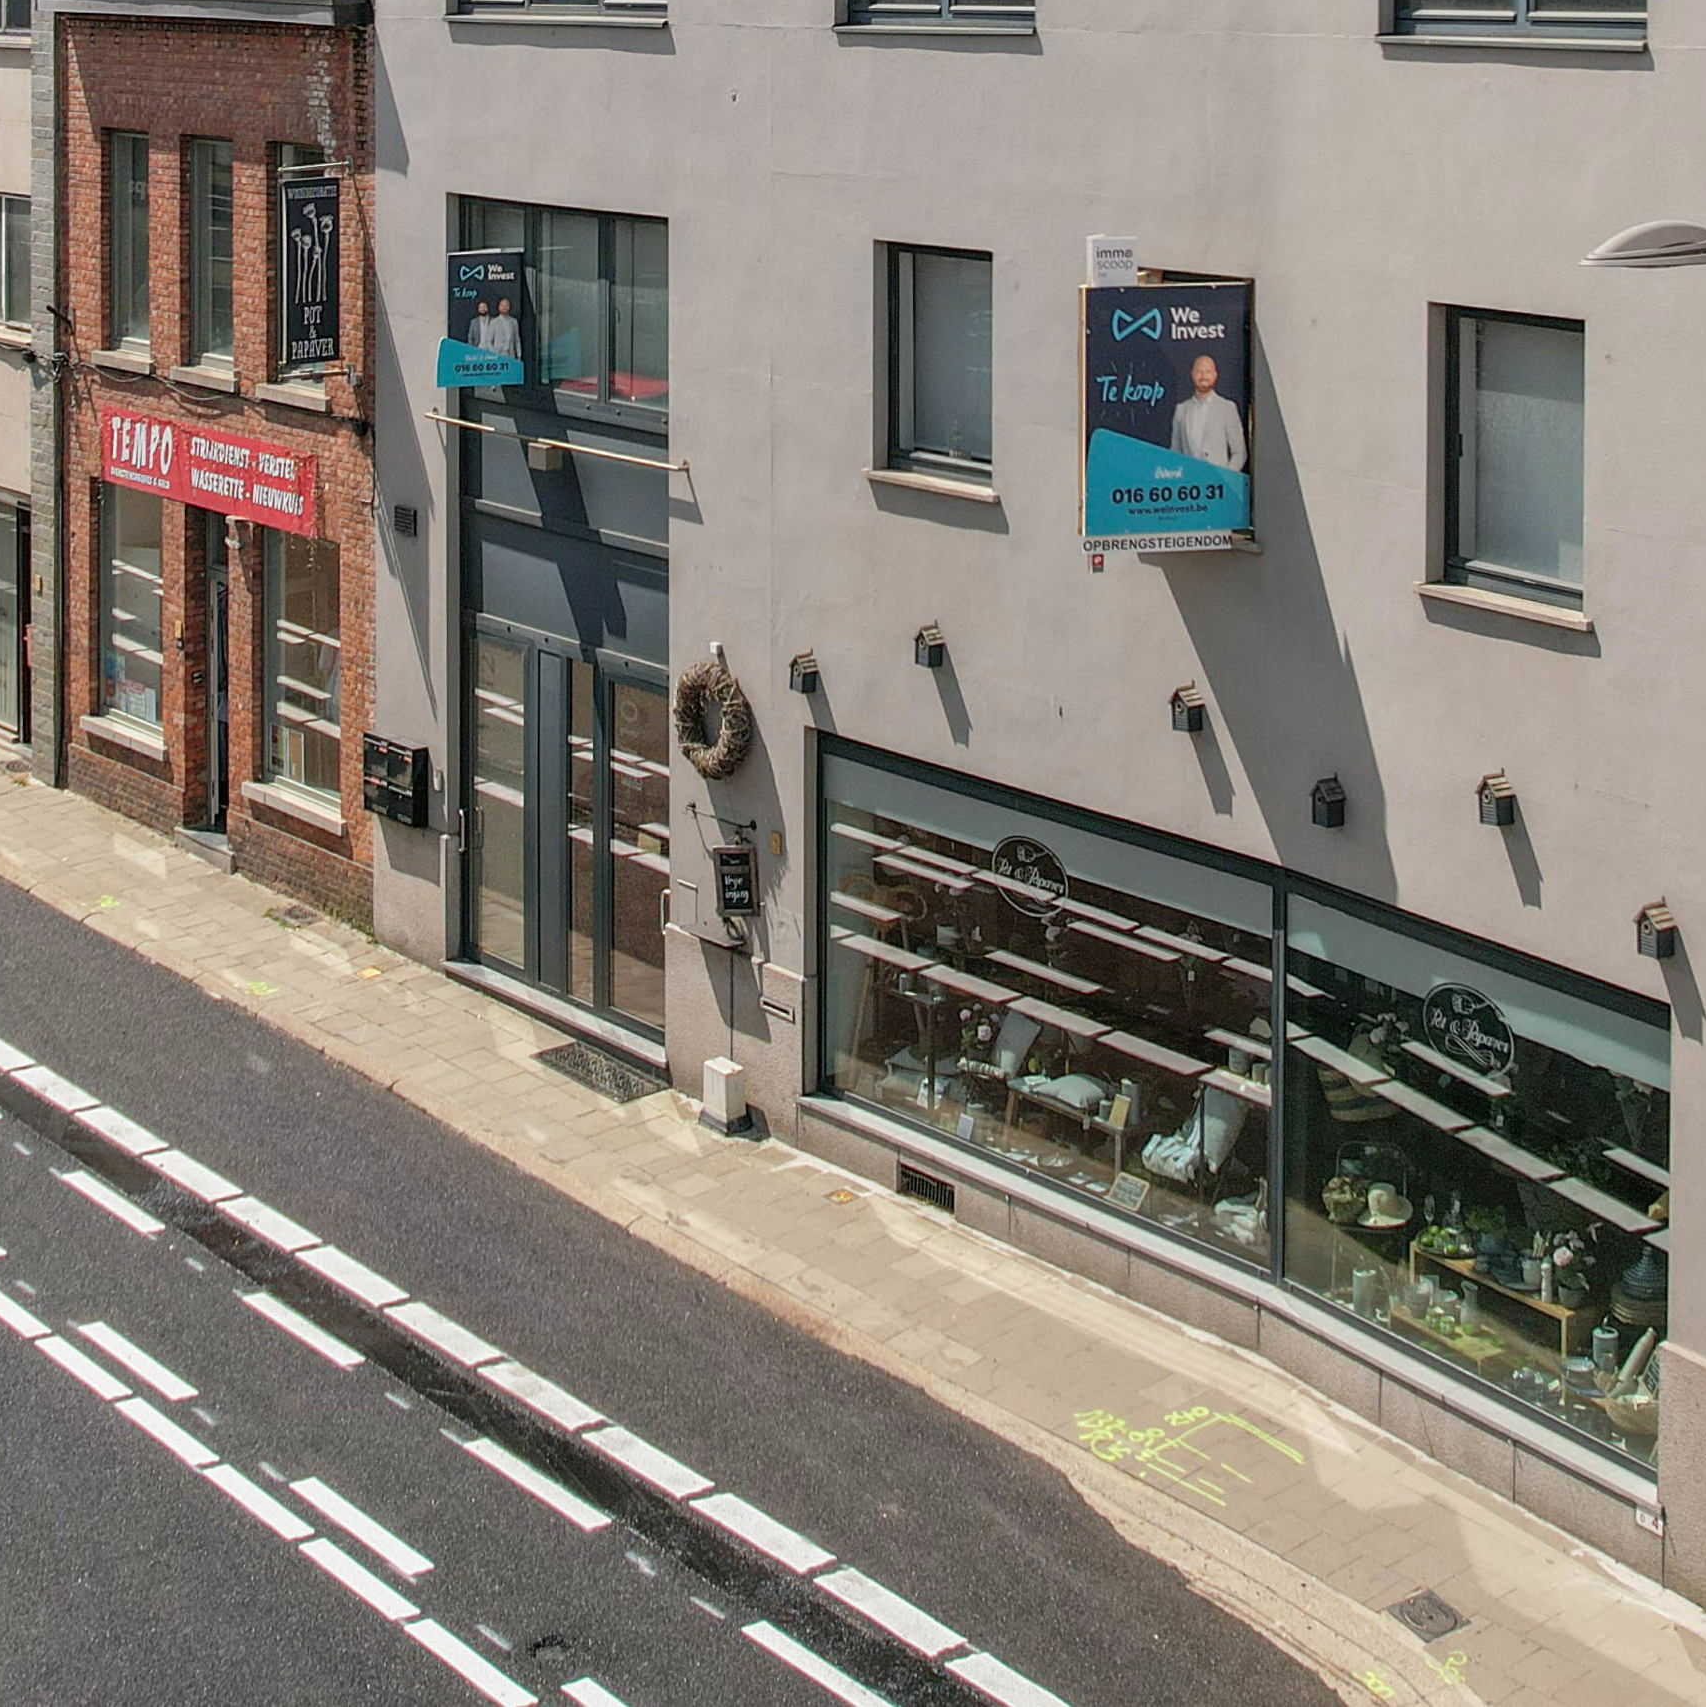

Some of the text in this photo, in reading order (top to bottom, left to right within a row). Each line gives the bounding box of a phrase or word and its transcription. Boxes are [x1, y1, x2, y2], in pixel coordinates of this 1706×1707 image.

[487, 272, 514, 280] Invest
[303, 306, 322, 325] POT
[1170, 306, 1200, 323] We
[309, 325, 317, 339] &
[1170, 323, 1225, 340] Invest
[291, 338, 335, 360] PAPAVER
[1096, 375, 1165, 404] Te koop
[110, 416, 173, 476] TEMPO
[190, 436, 250, 469] STRIJKDIENST
[258, 452, 296, 480] VERSTEL
[191, 468, 244, 502] WASSERETTE
[252, 484, 304, 516] NIEUWKUIS
[1112, 483, 1224, 504] 016 60 60 31
[1128, 503, 1209, 515] www.weinvest.be
[1083, 535, 1232, 552] OPBRENGSTEIGENDOM
[1461, 1018, 1509, 1054] Papaver
